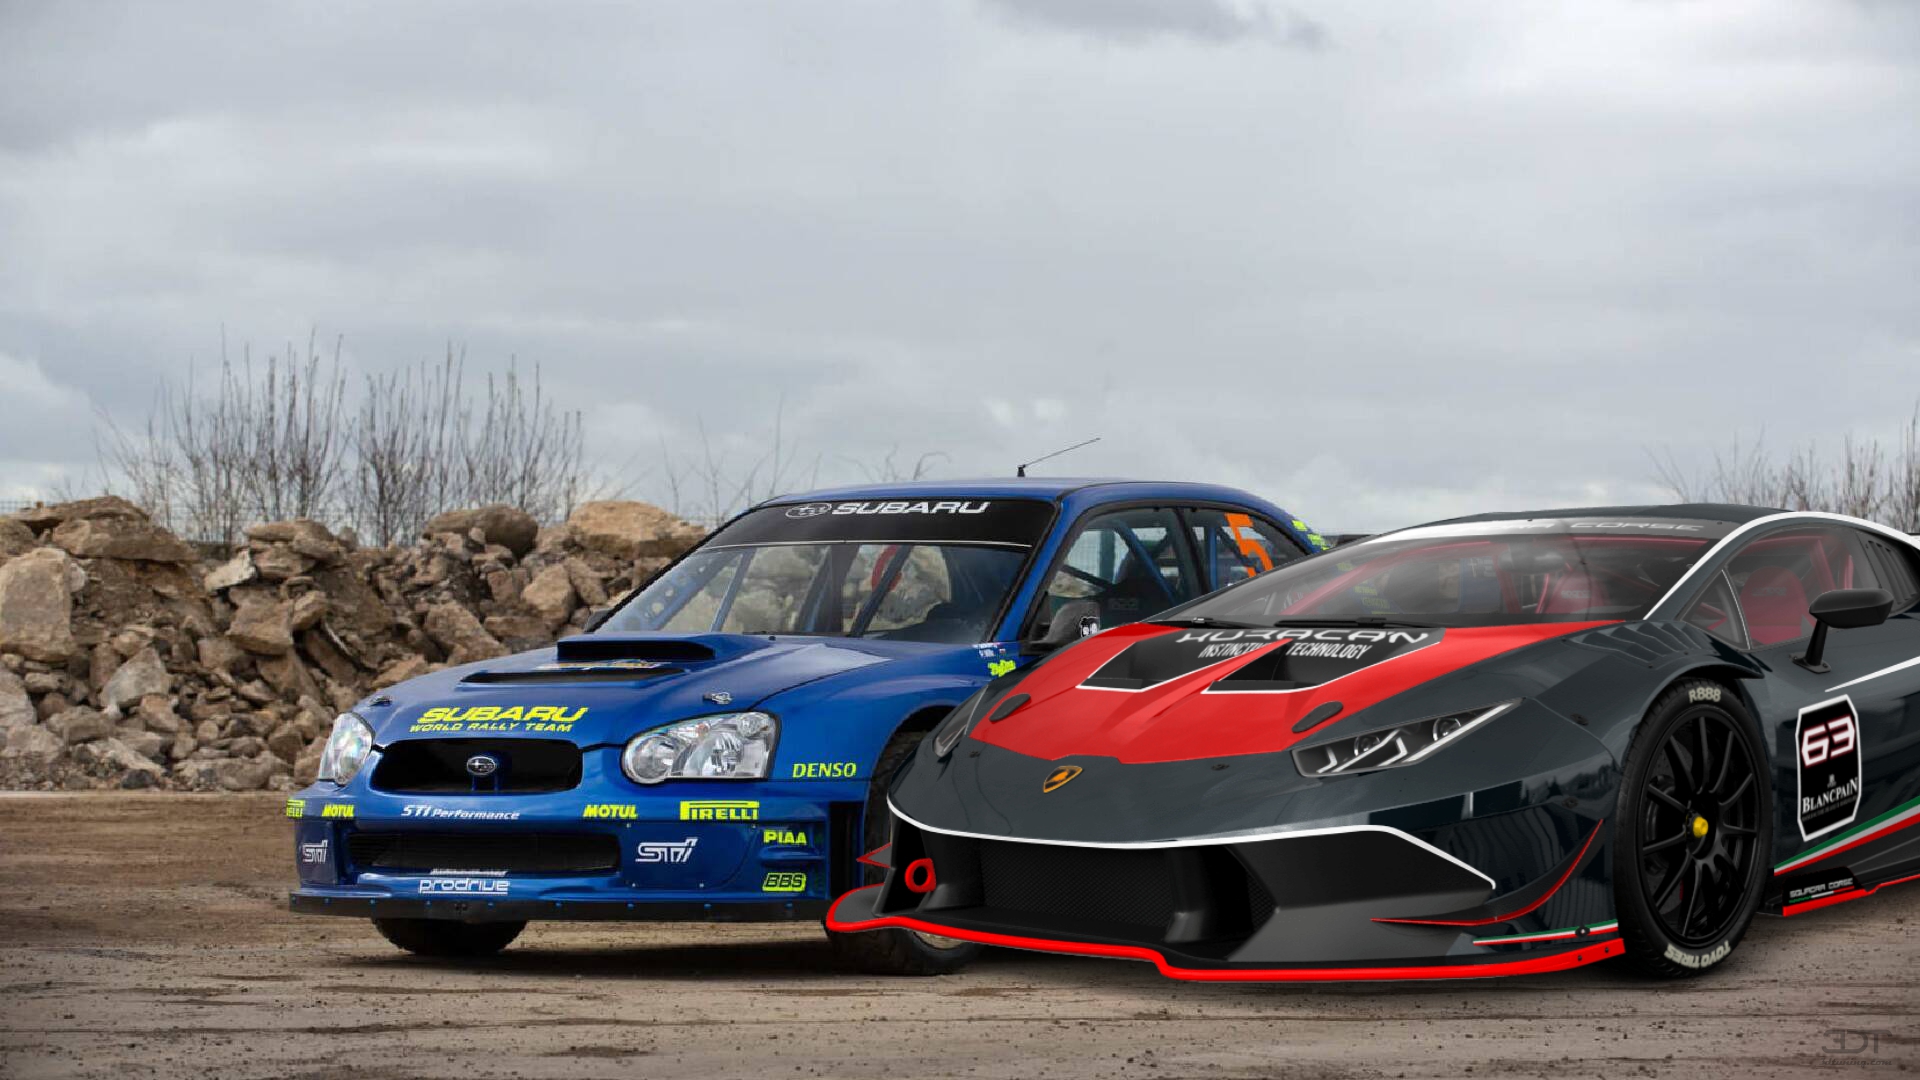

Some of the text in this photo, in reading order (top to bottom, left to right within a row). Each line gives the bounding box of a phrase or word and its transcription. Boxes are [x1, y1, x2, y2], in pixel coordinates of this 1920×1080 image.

[832, 501, 990, 515] SUBARU
[1286, 642, 1373, 660] TECHNOLOGY
[1688, 686, 1722, 703] R888
[417, 706, 589, 724] SUBARU
[409, 722, 573, 733] WORLD RALLY TEAM
[1802, 716, 1855, 767] 63
[792, 762, 857, 779] DENSO
[321, 804, 355, 817] MOTUL
[401, 804, 520, 820] STI Performance
[583, 804, 637, 818] MOTUL
[680, 800, 760, 821] PIRELLI
[763, 830, 807, 844] PIAA
[418, 878, 510, 895] prodrive
[764, 873, 806, 891] BBS
[1663, 939, 1731, 968] TOYO TIRES
